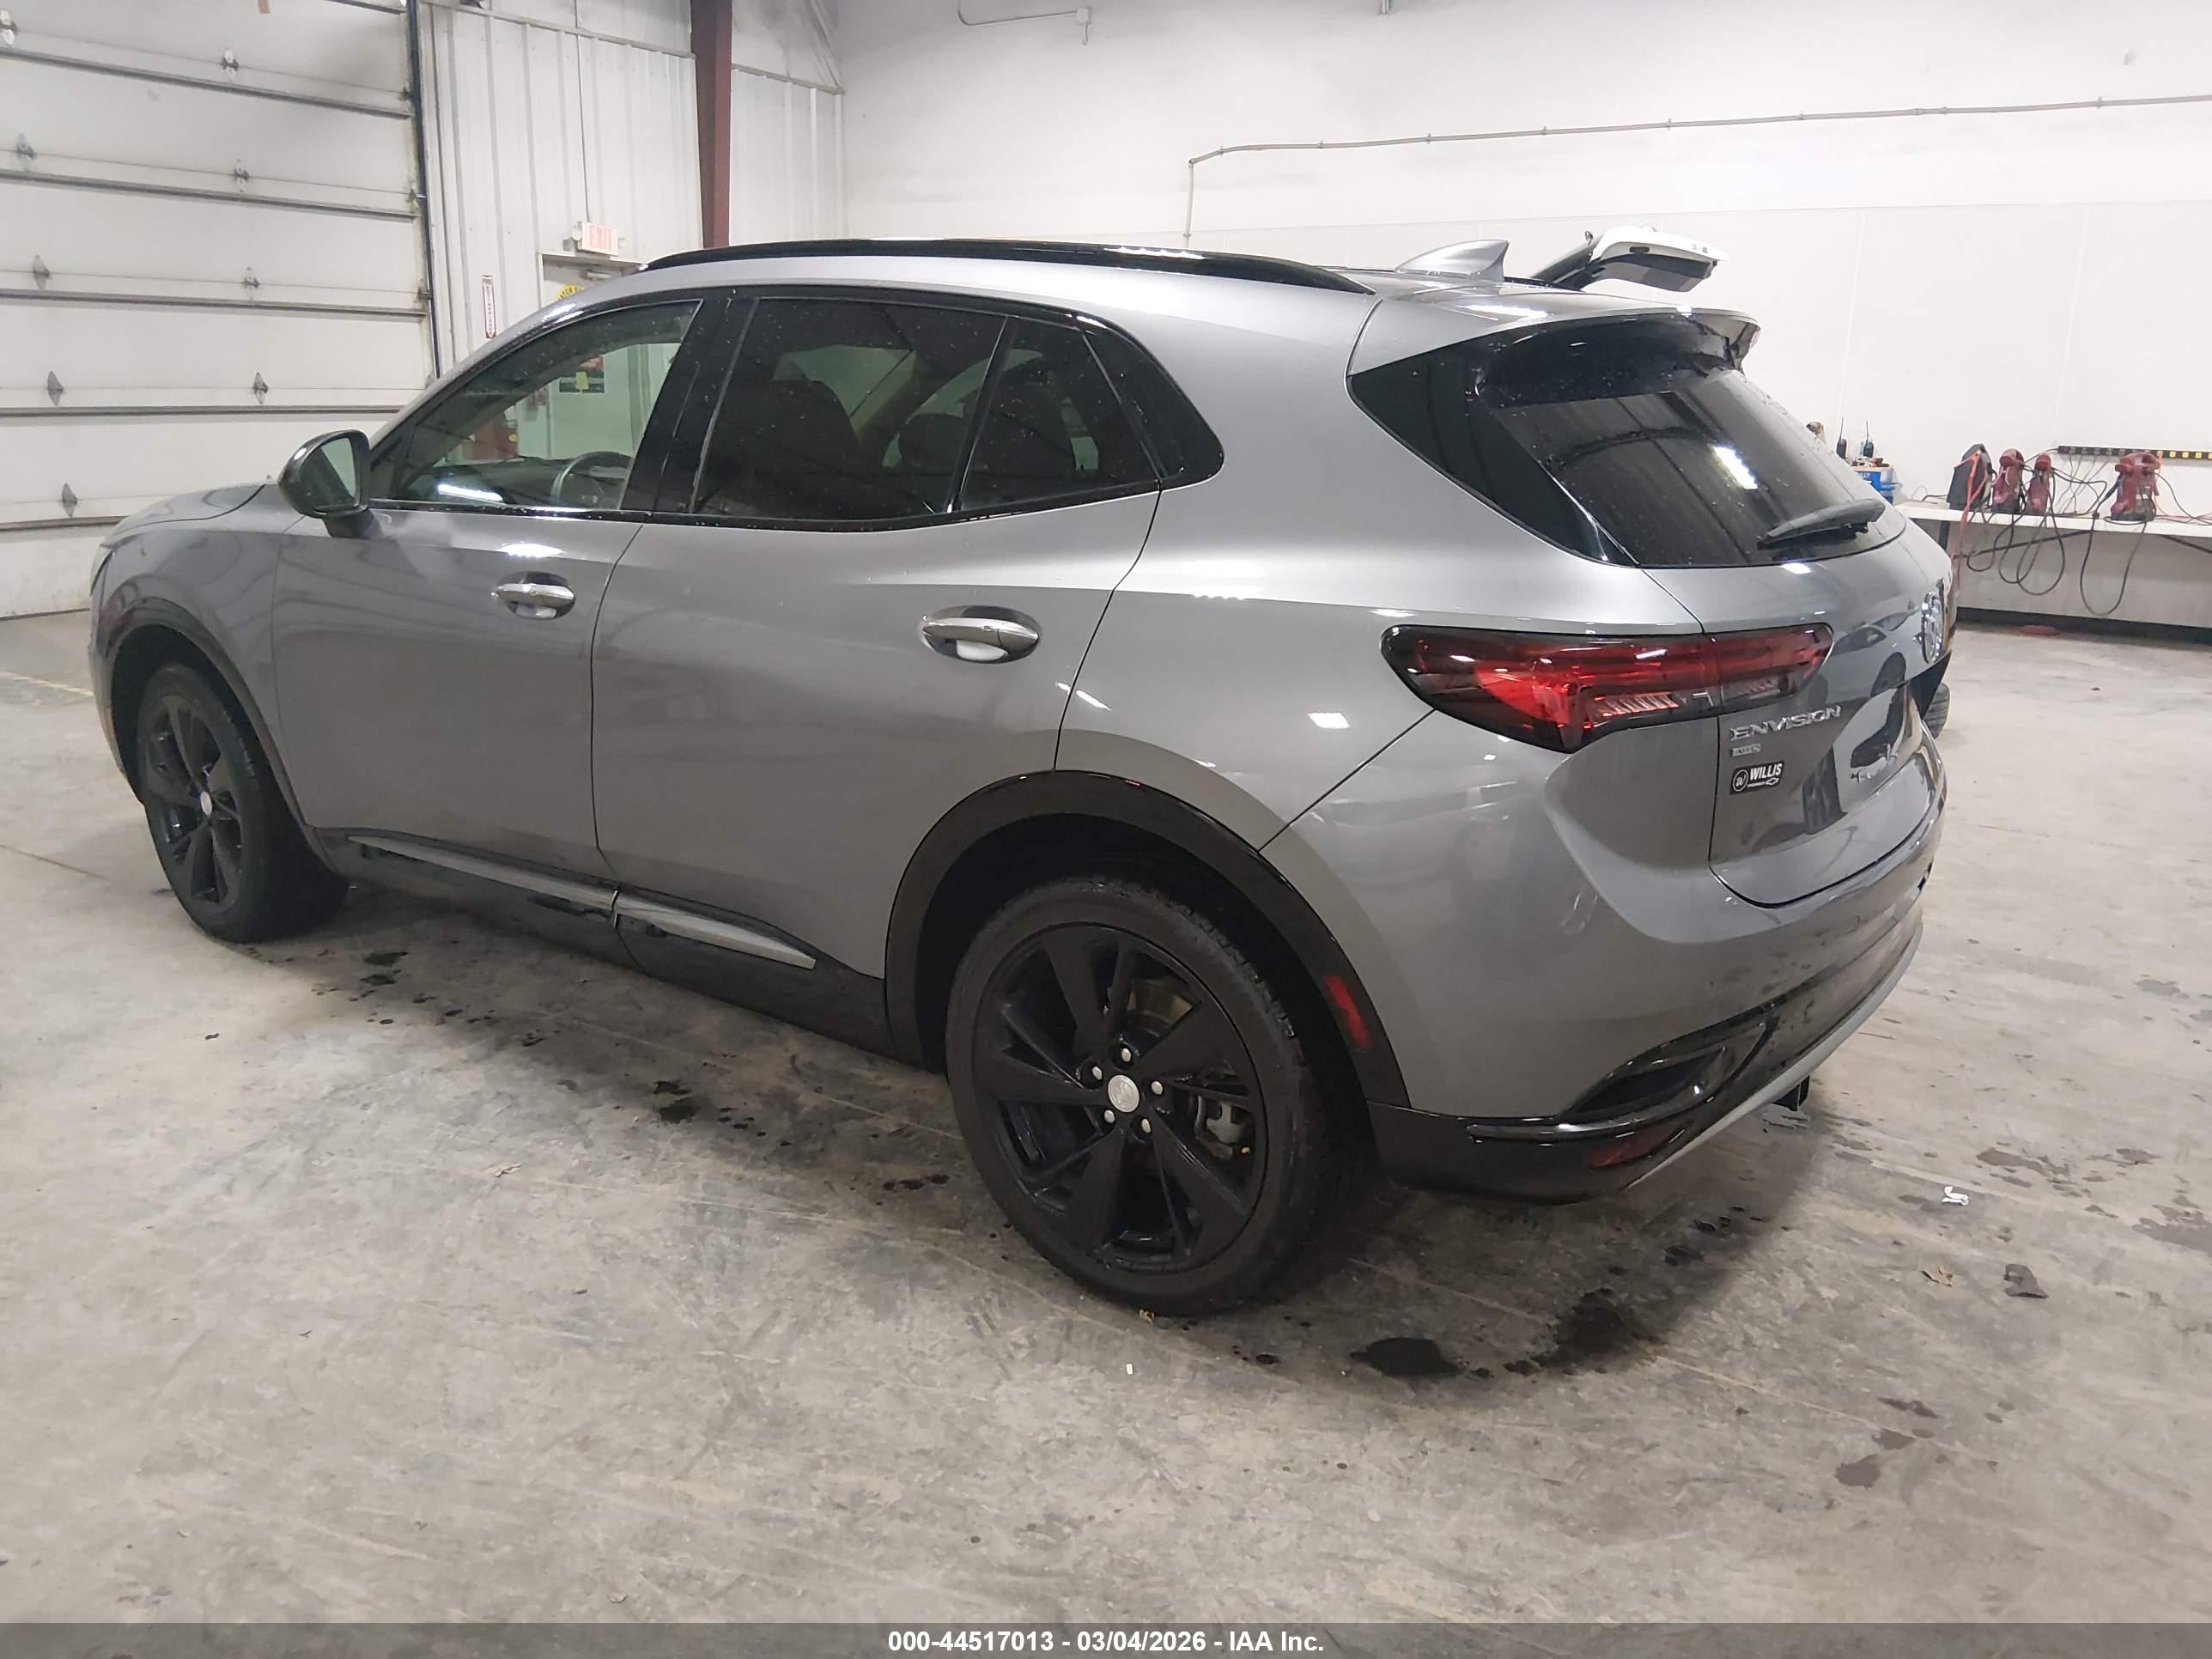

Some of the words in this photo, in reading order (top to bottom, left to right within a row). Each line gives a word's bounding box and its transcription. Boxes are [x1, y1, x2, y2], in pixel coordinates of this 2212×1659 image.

[590, 225, 612, 251] EXIT
[1730, 705, 1842, 741] ENVISION
[1750, 763, 1784, 781] WILLIS
